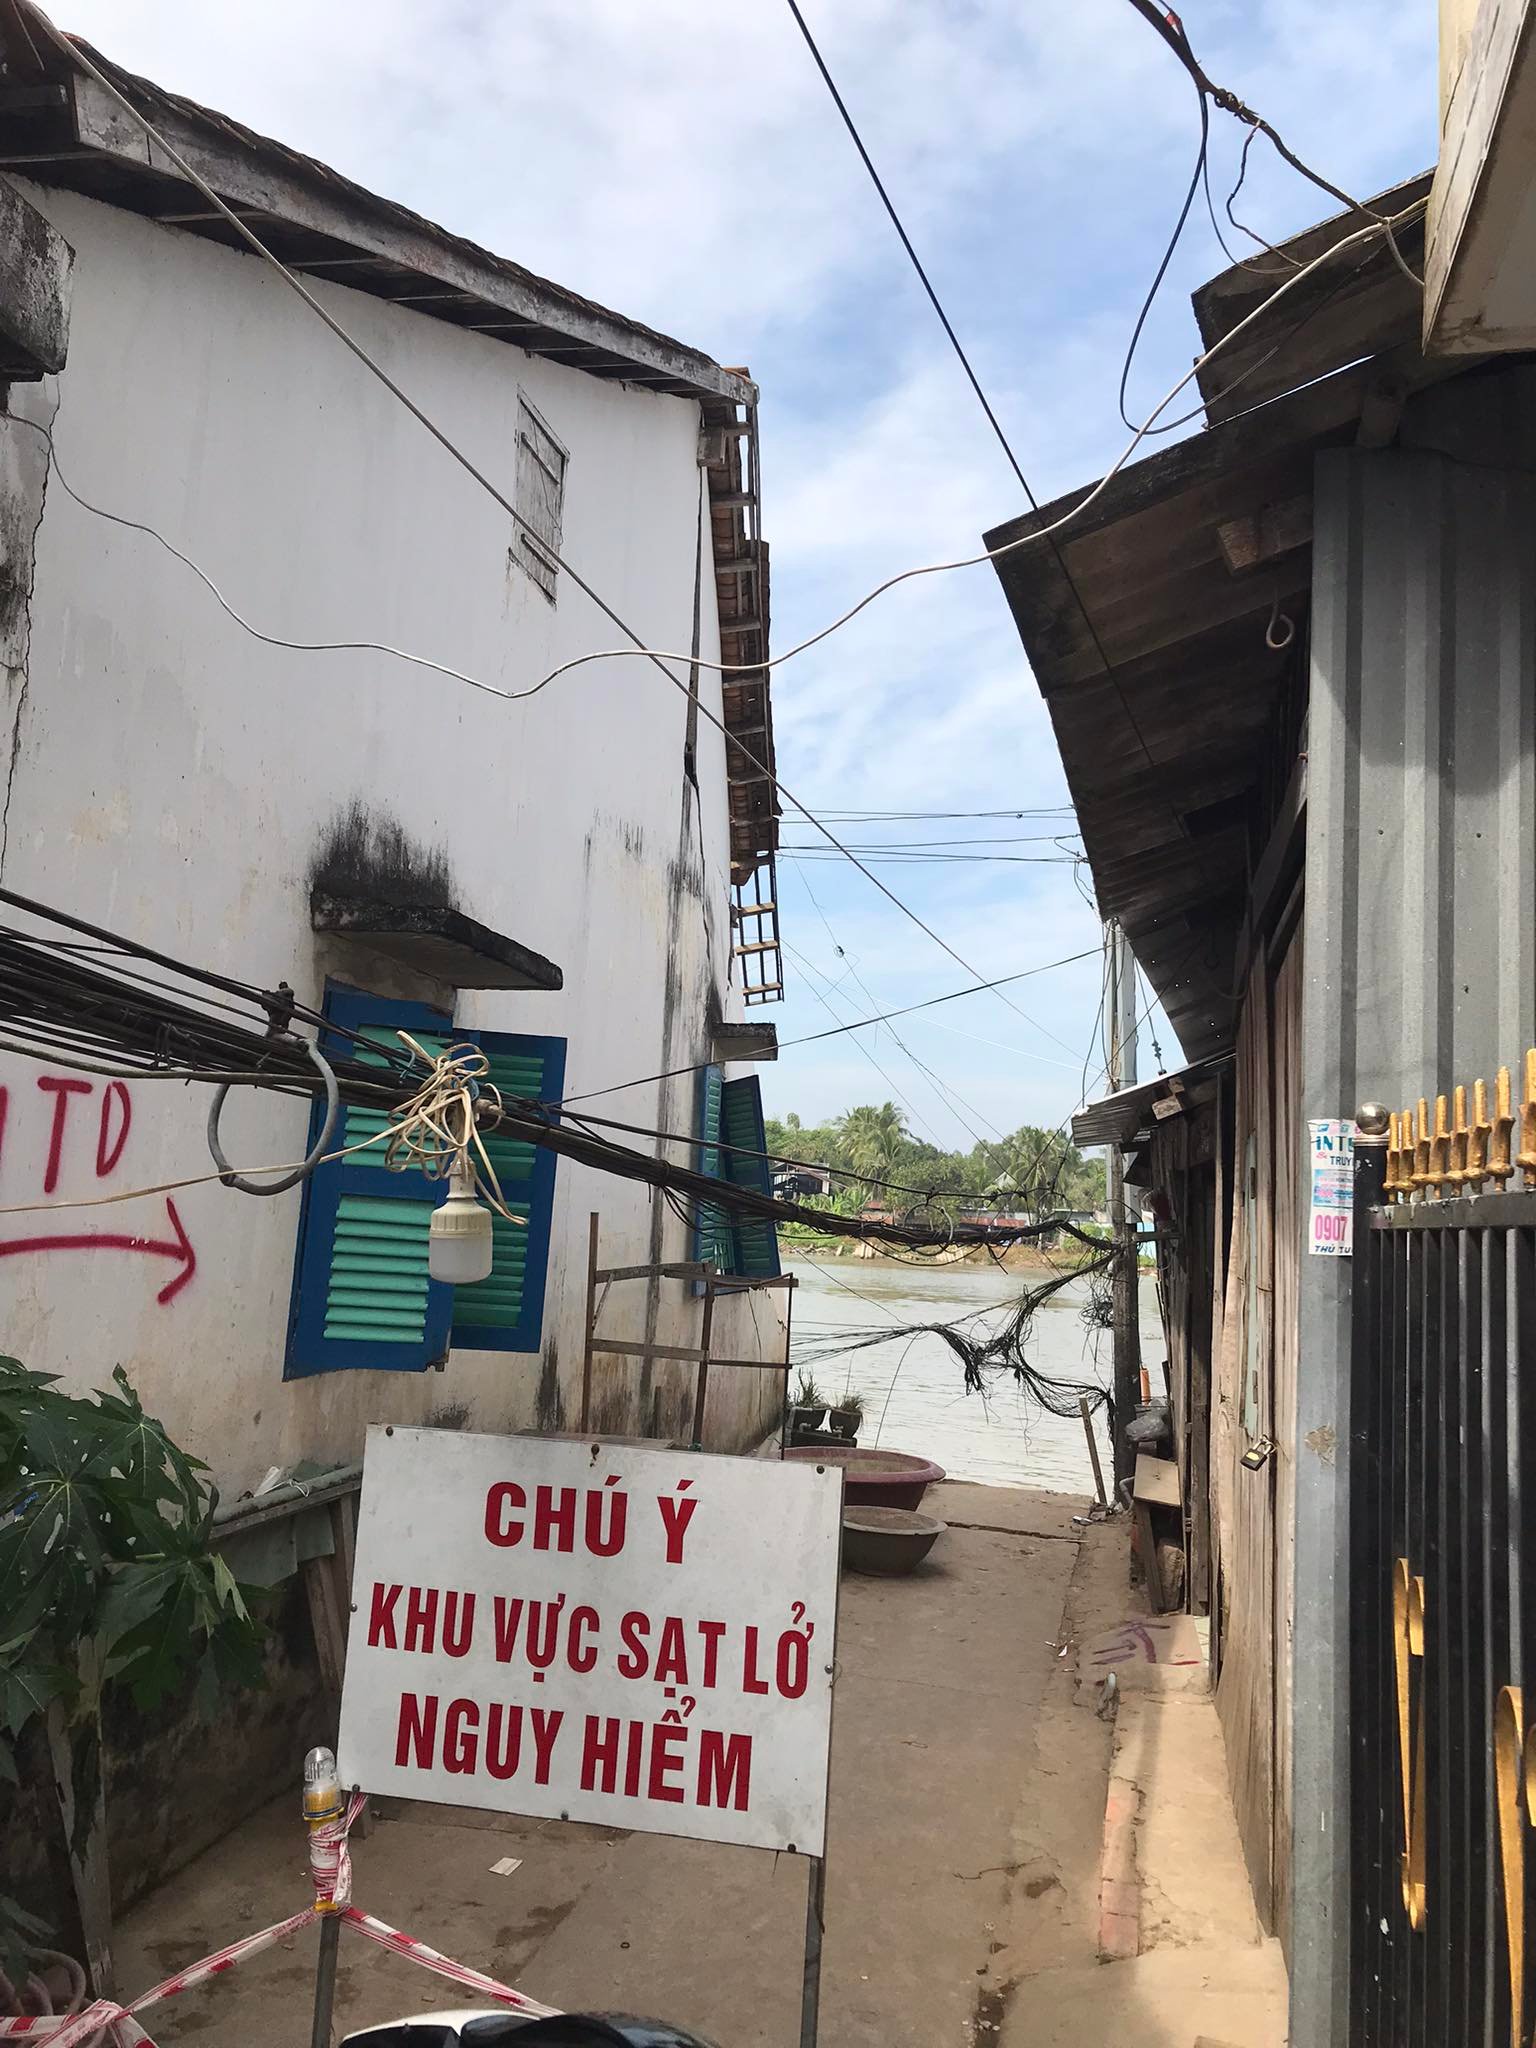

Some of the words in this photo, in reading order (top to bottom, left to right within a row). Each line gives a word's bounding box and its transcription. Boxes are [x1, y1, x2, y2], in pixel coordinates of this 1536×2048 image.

[1330, 1155, 1354, 1166] TRUY
[1315, 1214, 1348, 1241] 0907
[485, 1475, 628, 1557] CHÚ
[657, 1479, 698, 1564] Ý
[367, 1583, 476, 1657] KHU
[494, 1593, 600, 1683] VỰC
[617, 1611, 726, 1698] SẠT
[743, 1601, 815, 1700] LỞ
[395, 1692, 564, 1785] NGUY
[580, 1695, 753, 1812] HIỂM
